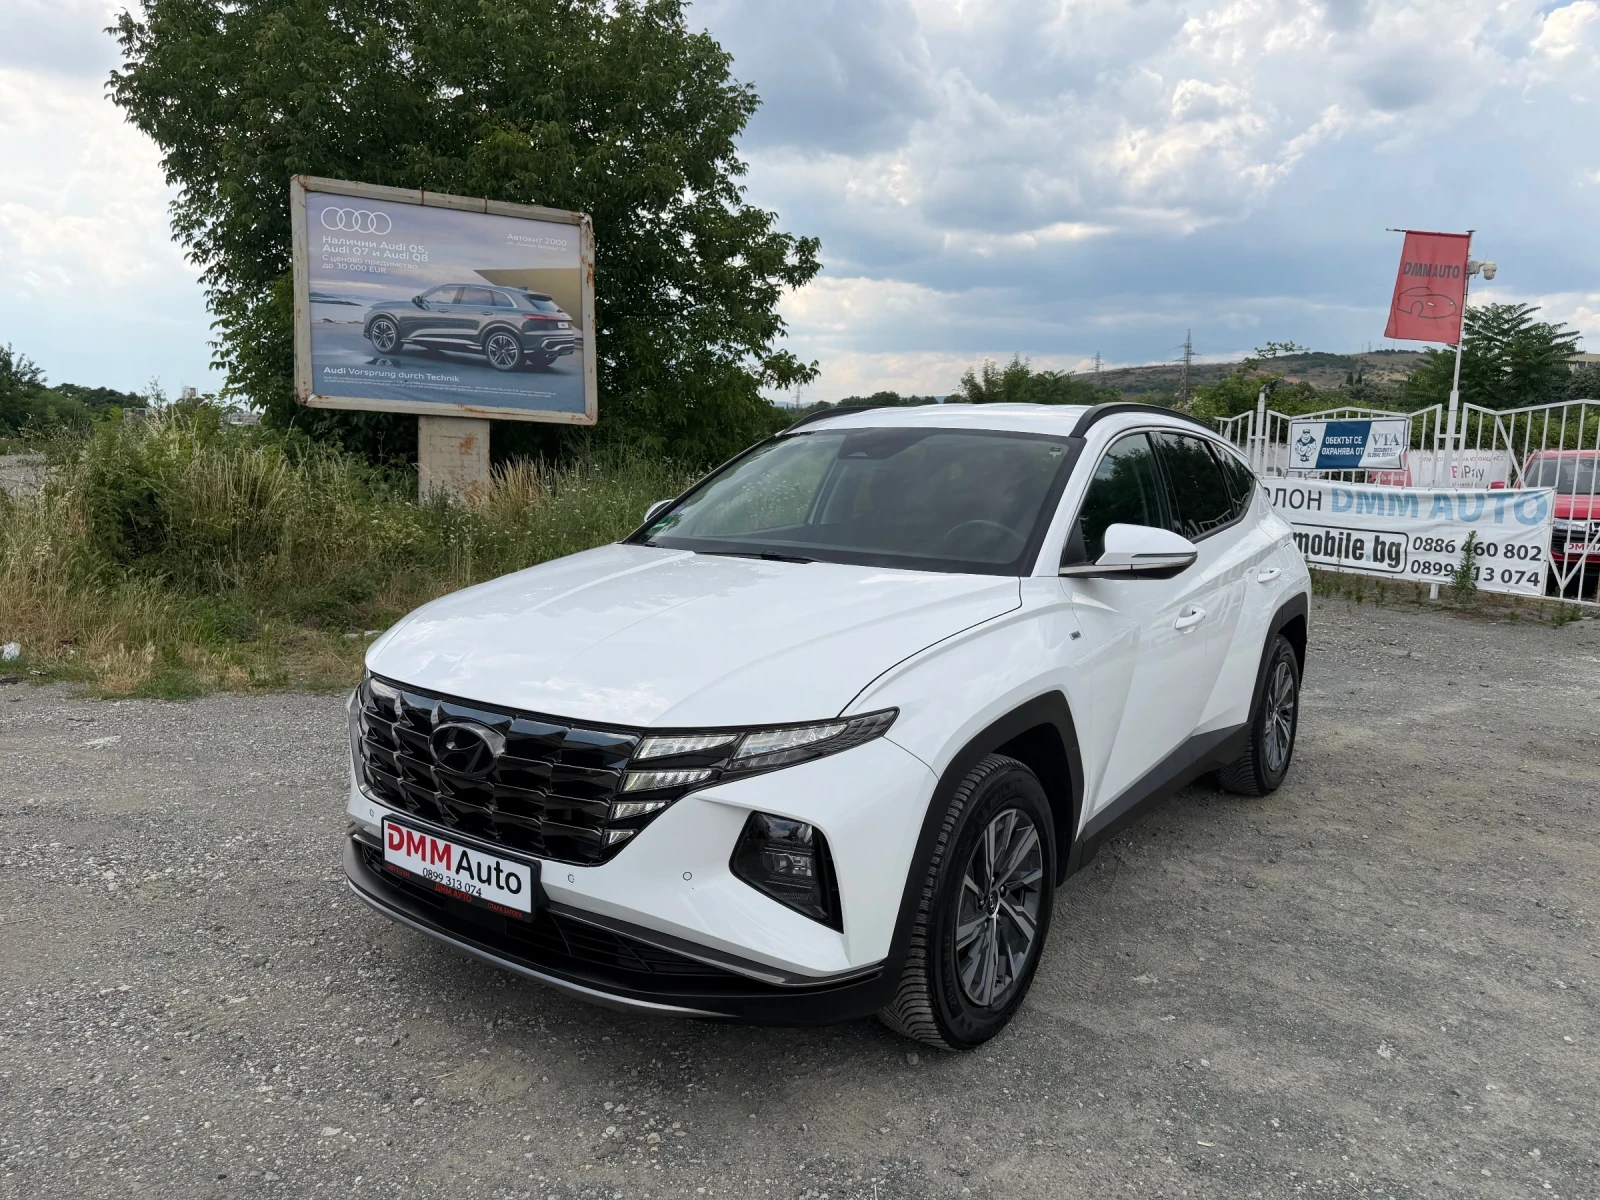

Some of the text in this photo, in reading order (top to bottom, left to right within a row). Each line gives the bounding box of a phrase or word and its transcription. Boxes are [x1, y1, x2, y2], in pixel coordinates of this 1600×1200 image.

[322, 235, 429, 254] Налични Audi Q5,
[507, 233, 543, 244] Автохит
[544, 237, 567, 246] 2000
[322, 244, 349, 254] Audi
[352, 246, 369, 256] Q7
[383, 250, 409, 260] Audi
[412, 253, 429, 262] Q8
[330, 255, 363, 264] ценово
[365, 259, 418, 270] предимство
[336, 262, 348, 270] 30
[349, 263, 367, 272] 000
[369, 266, 387, 274] EUR
[324, 366, 460, 382] Audi Vorsprung durch Technik
[1325, 436, 1363, 444] ОБЕКТЪТ СЕ
[1371, 433, 1400, 446] VTA
[1321, 447, 1365, 456] ОХРАНЯВА ОТ
[1331, 487, 1548, 525] DMM AUTO
[1293, 530, 1402, 568] mobile.bg
[1412, 536, 1456, 554] 0886
[1503, 543, 1542, 561] 802
[1410, 559, 1455, 577] 0899
[1500, 569, 1541, 587] 074
[422, 867, 482, 898] 0899 313 074
